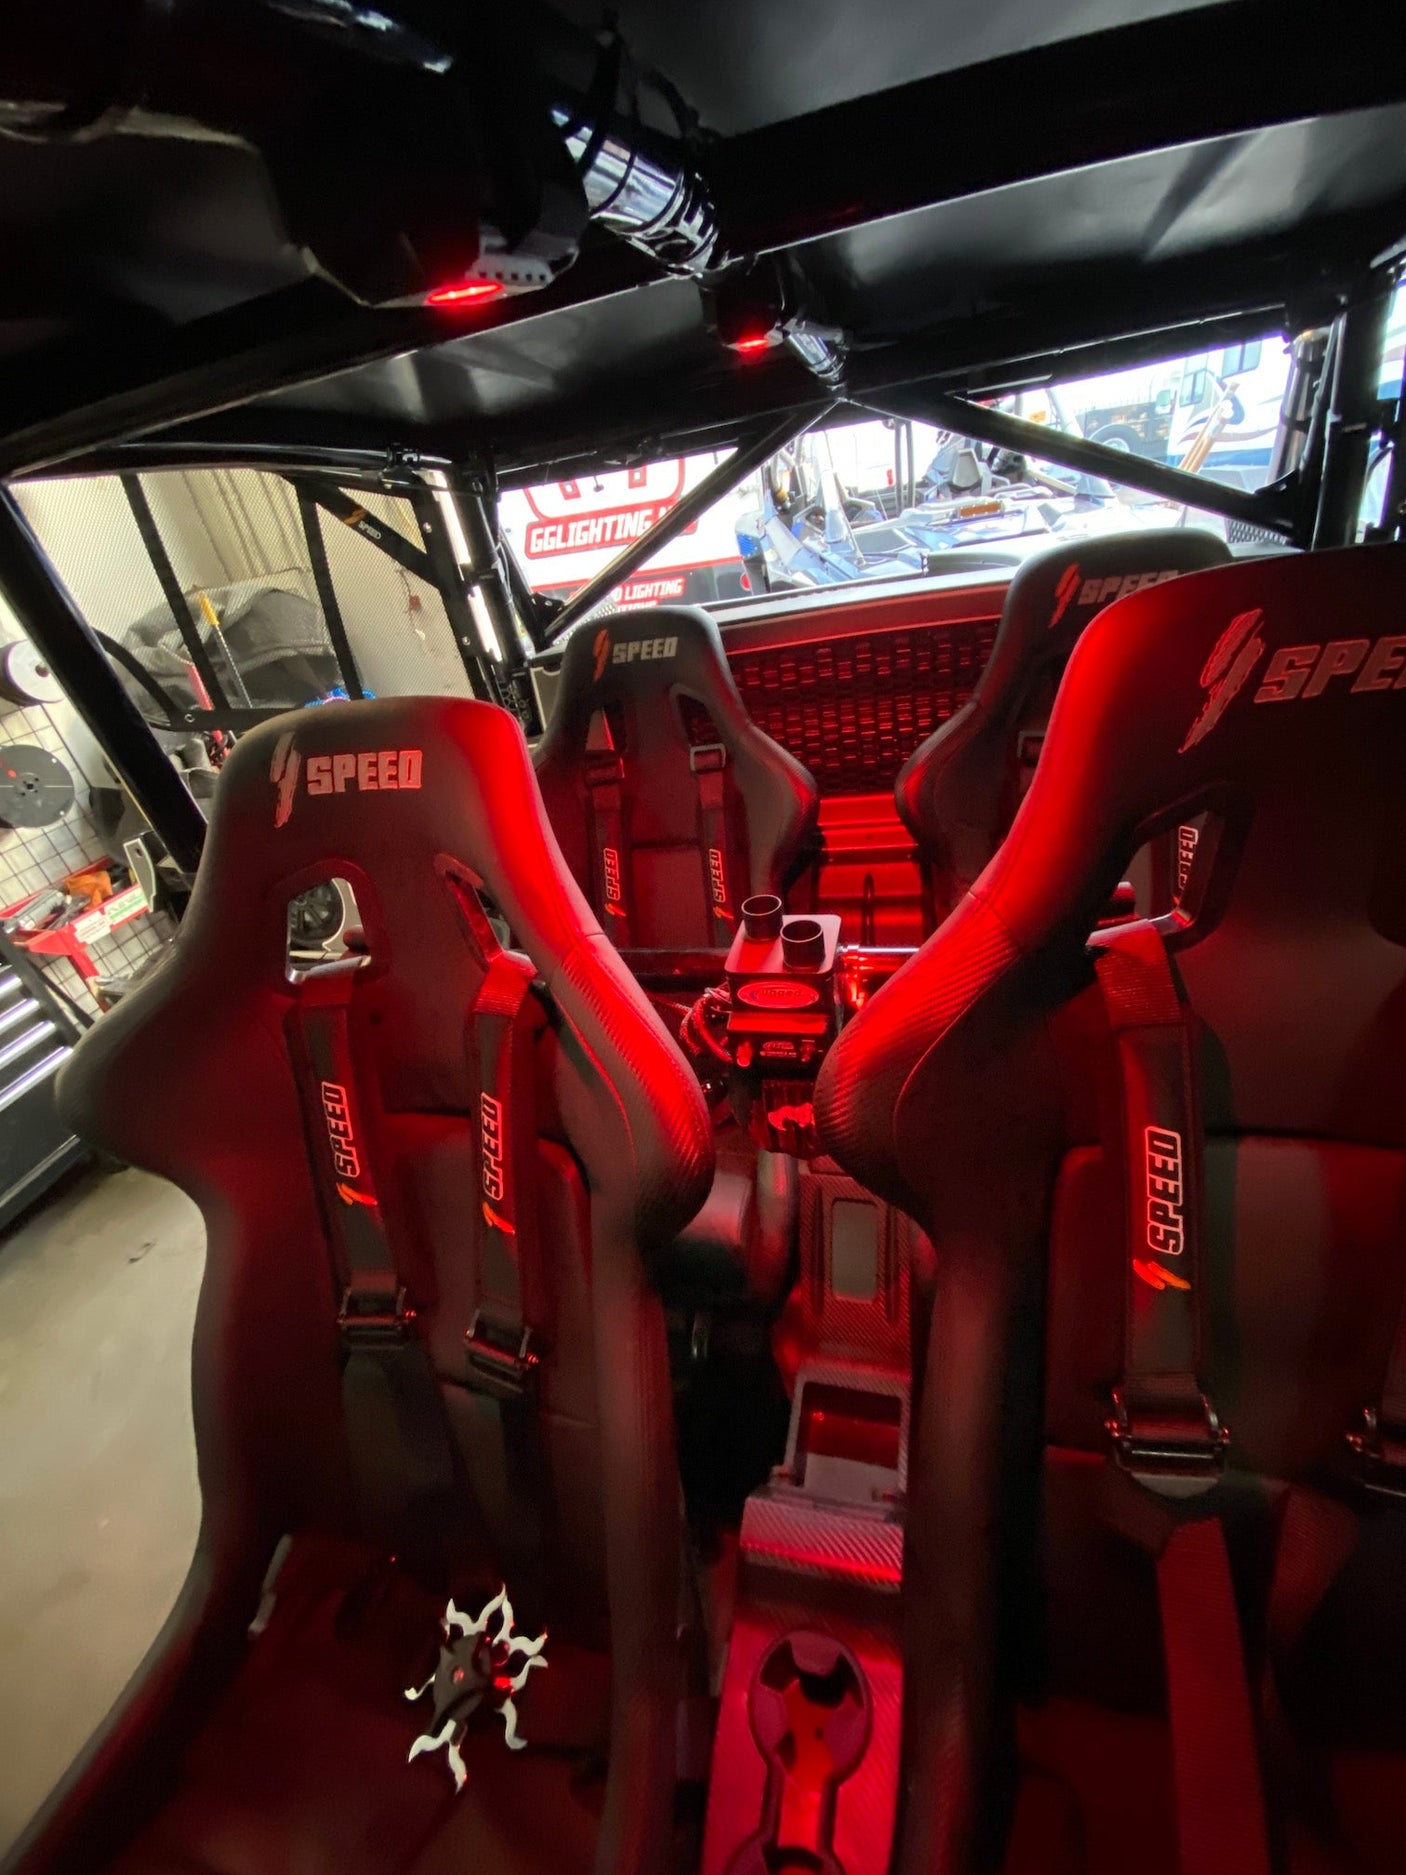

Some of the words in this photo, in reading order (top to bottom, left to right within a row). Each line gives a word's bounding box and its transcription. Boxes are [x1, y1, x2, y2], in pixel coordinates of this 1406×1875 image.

[624, 578, 683, 601] LIGHTING
[612, 636, 679, 665] SPEED
[1253, 634, 1406, 704] SPE
[306, 749, 423, 796] SPEED
[603, 847, 621, 901] SPEED
[709, 848, 726, 903] SPEED
[321, 1081, 361, 1178] SPEED
[480, 1091, 504, 1201] SPEED
[1144, 1125, 1185, 1256] SPEED
